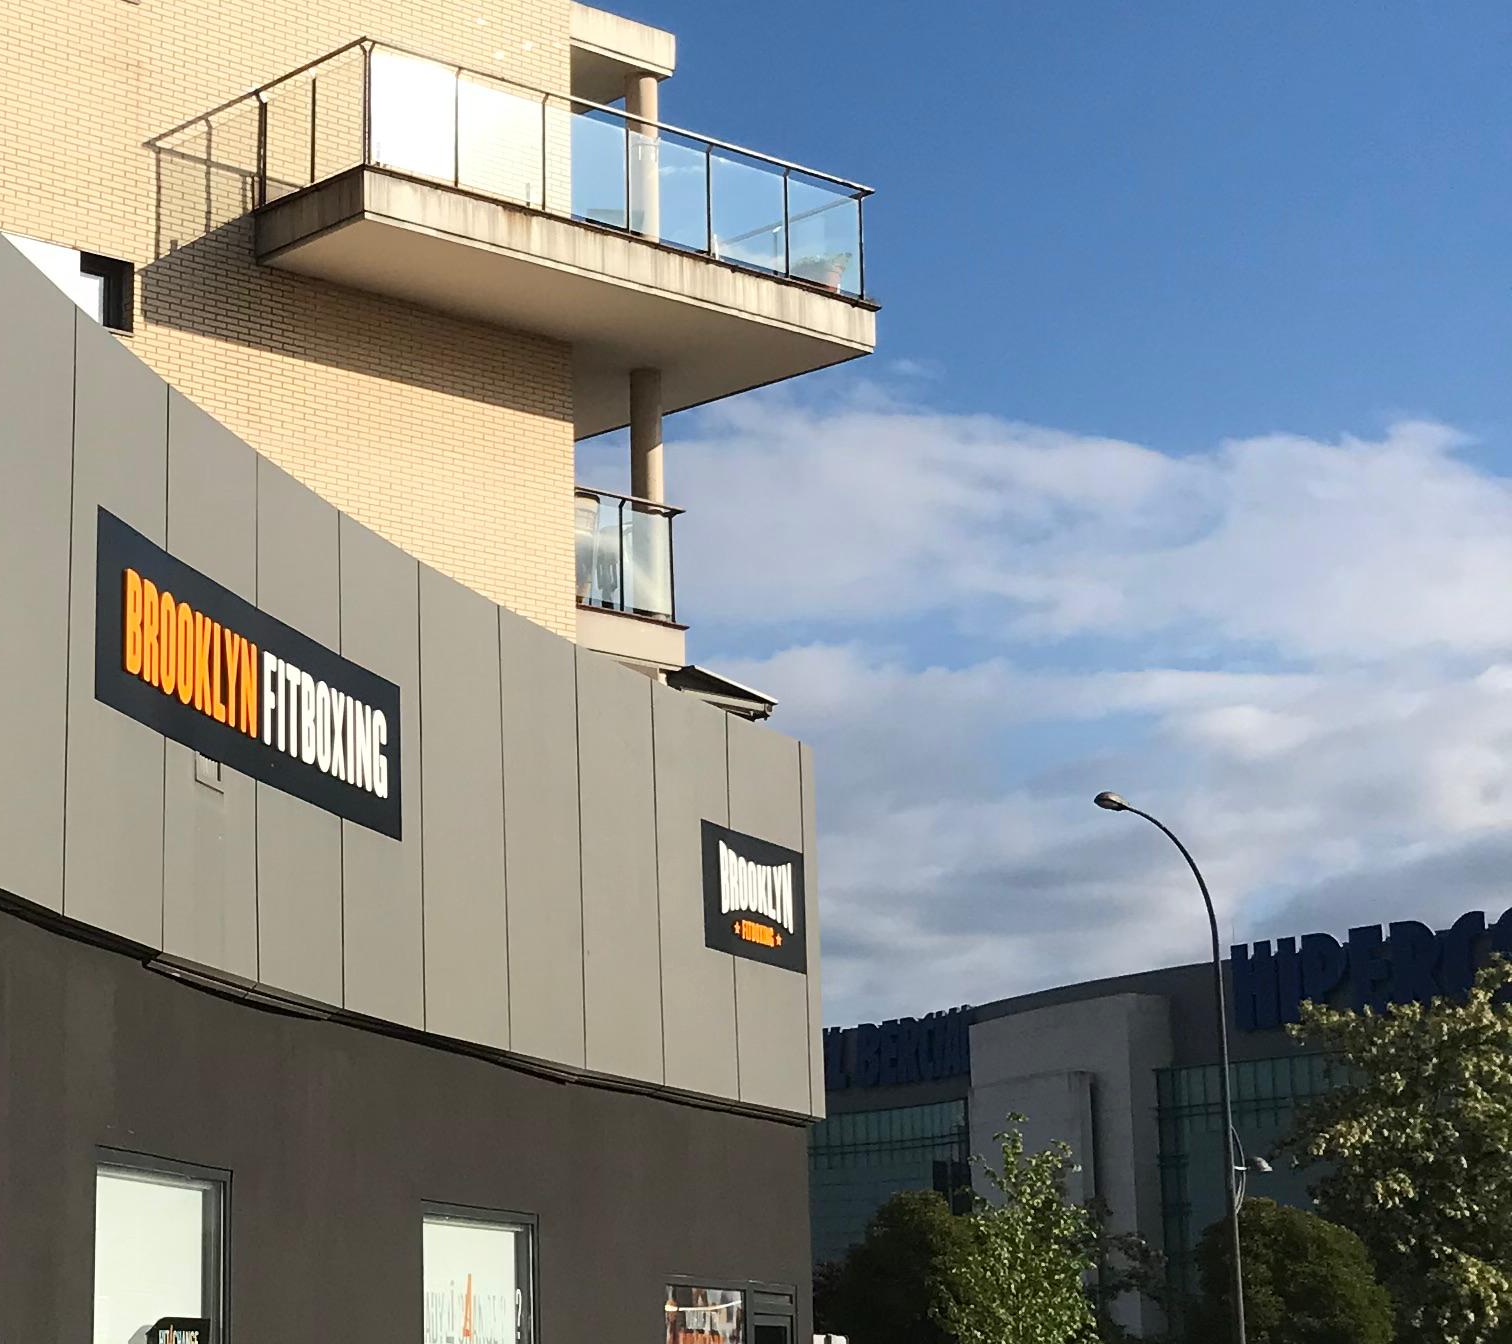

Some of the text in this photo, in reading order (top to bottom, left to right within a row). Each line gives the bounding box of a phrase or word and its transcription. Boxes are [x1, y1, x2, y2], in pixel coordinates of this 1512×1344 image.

[123, 567, 389, 800] BROOKLYN FITBOXING
[718, 839, 794, 935] BROOKLYN
